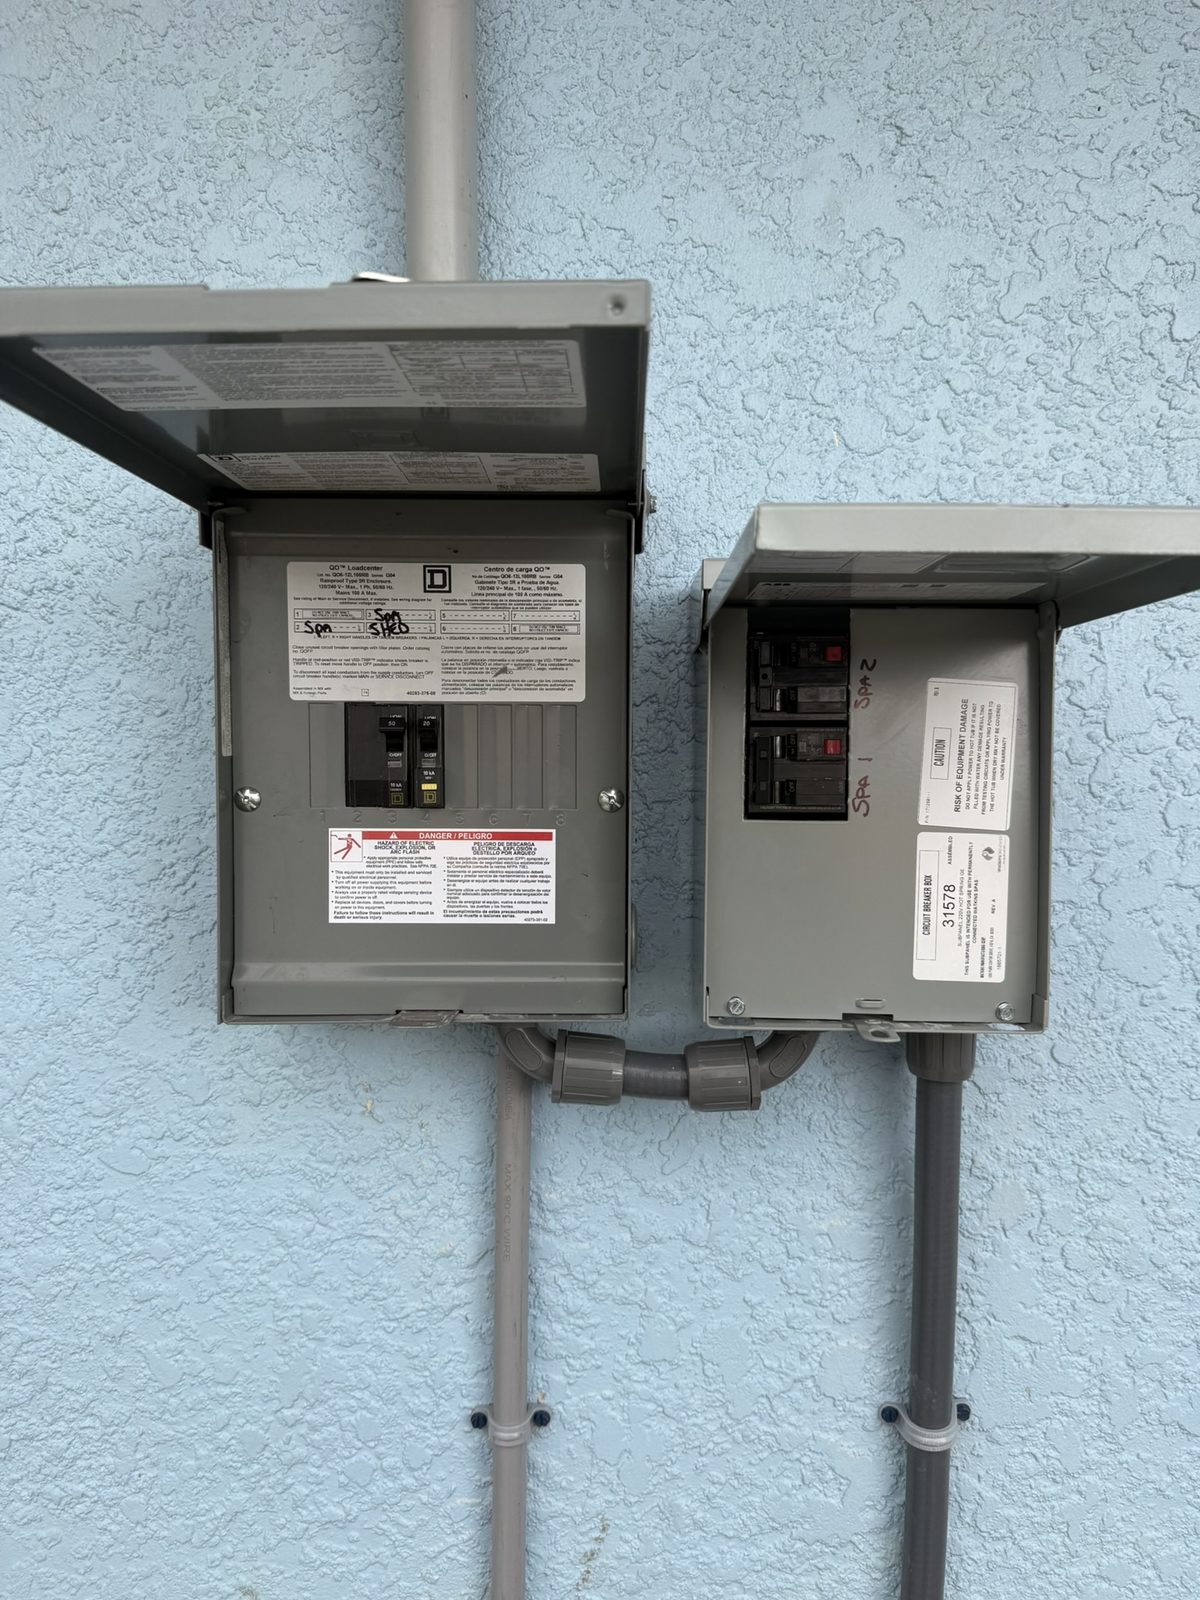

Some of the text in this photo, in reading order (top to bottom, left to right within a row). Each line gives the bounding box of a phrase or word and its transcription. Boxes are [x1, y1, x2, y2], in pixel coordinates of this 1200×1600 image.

[854, 658, 877, 709] SPA 2
[959, 698, 968, 732] DAMAGE
[934, 739, 946, 767] CAUTION
[956, 733, 966, 779] EQUIPMENT
[852, 775, 871, 817] SPA
[956, 781, 963, 792] OF
[922, 875, 932, 936] CIRCUIT BREAKER BOX
[942, 884, 955, 928] 31578
